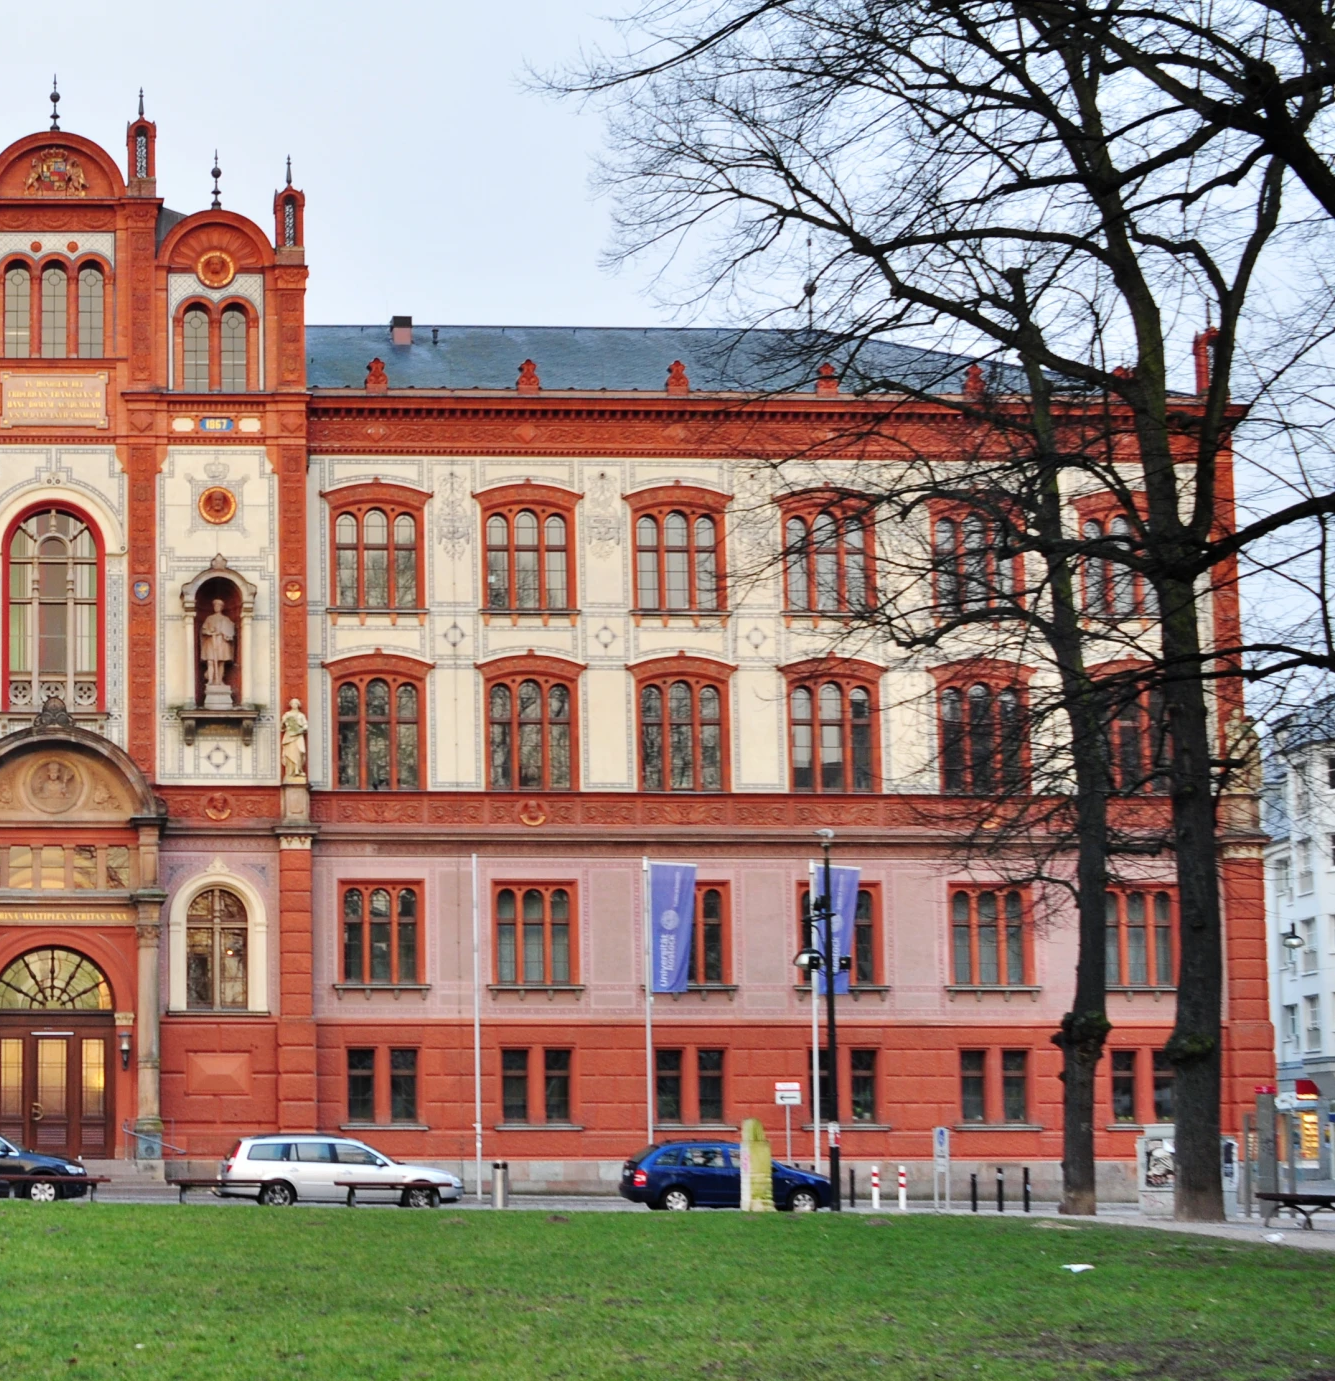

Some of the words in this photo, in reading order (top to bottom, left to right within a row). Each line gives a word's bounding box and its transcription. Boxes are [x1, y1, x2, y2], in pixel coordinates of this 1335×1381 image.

[205, 418, 228, 430] 1867
[659, 933, 669, 987] Universität
[666, 934, 676, 971] Rostock
